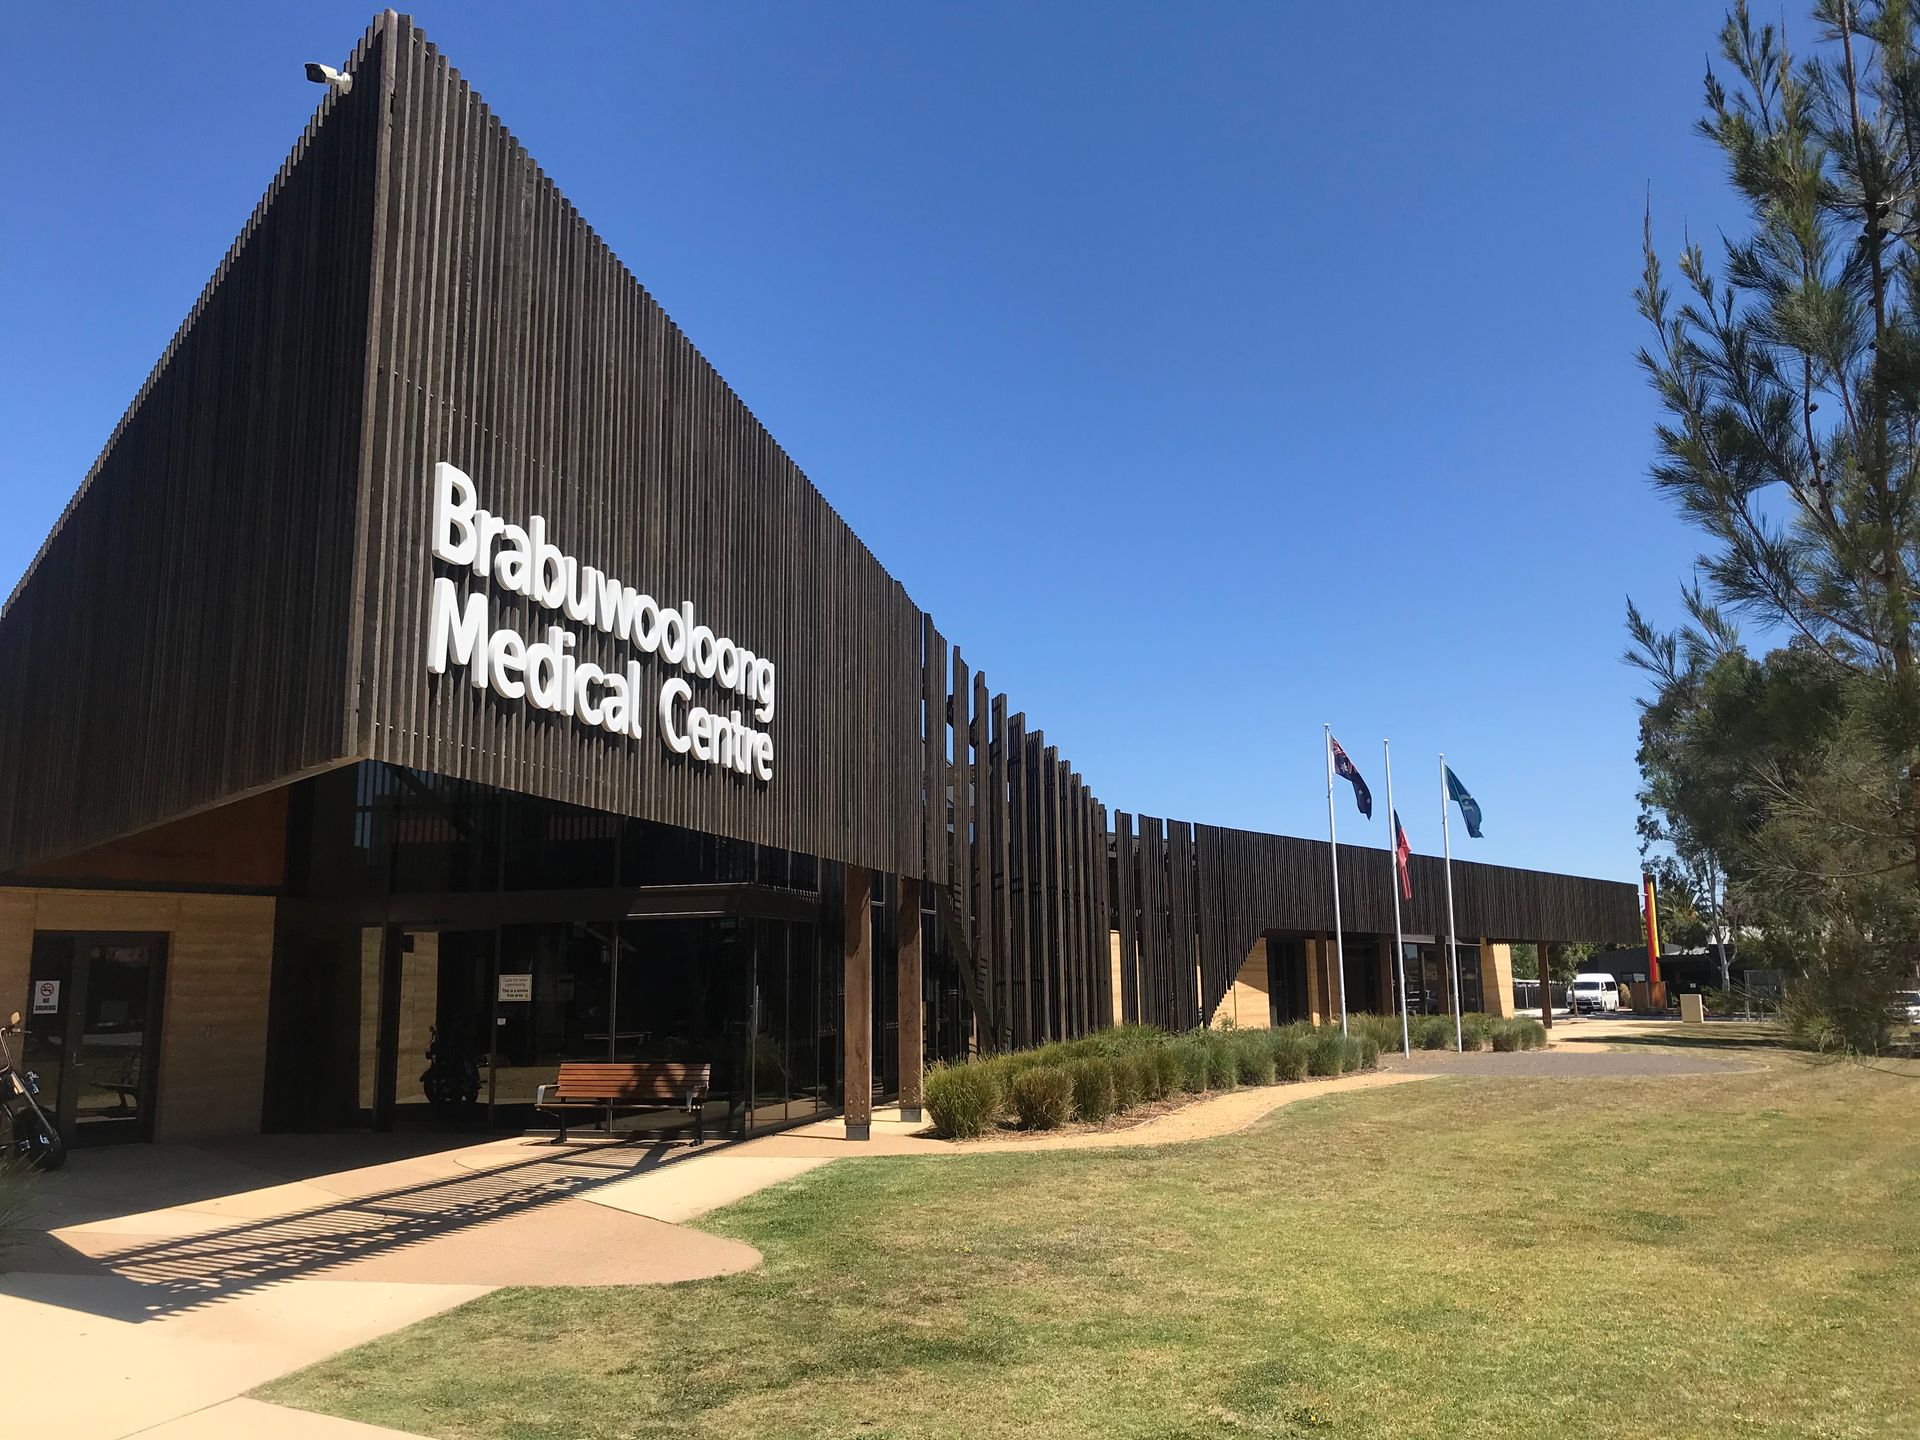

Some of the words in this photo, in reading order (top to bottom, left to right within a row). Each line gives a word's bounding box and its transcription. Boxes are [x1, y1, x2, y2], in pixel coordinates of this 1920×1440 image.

[427, 577, 642, 739] Medical
[659, 677, 775, 782] Centre
[432, 461, 776, 723] Brabuwooloong
